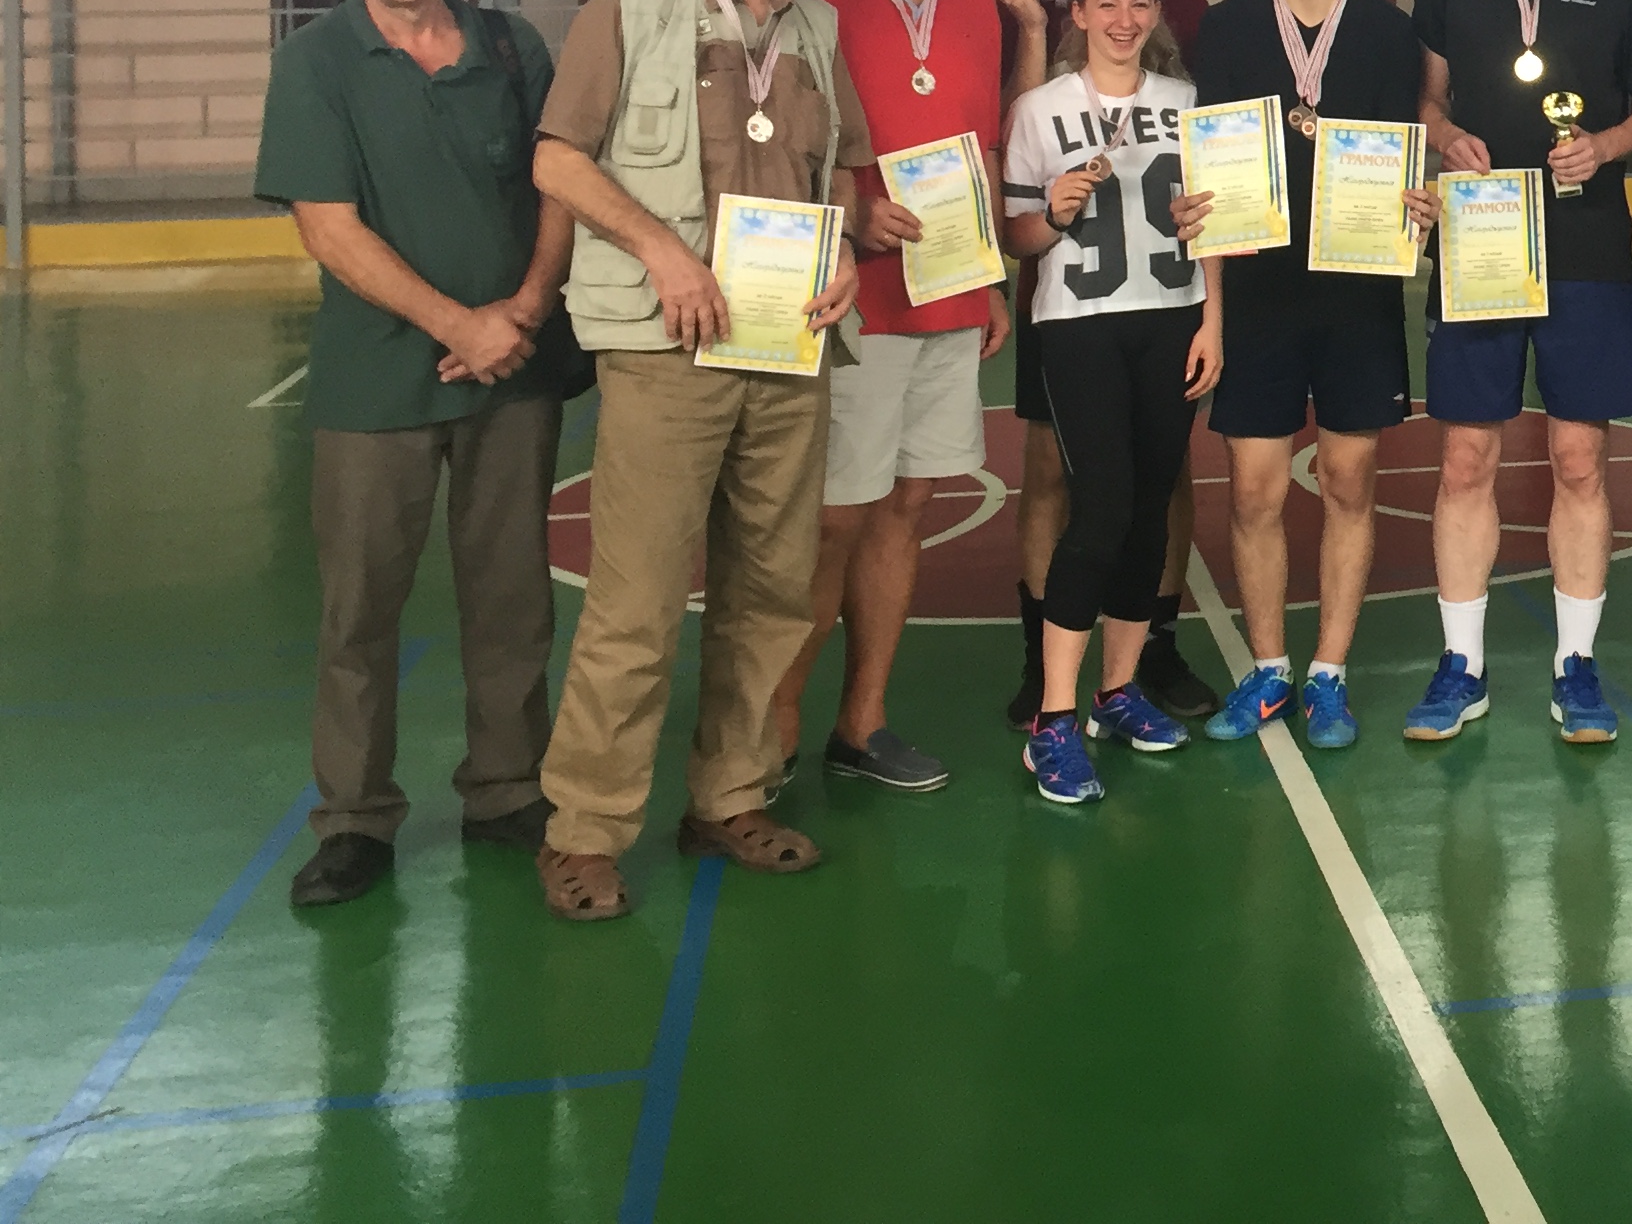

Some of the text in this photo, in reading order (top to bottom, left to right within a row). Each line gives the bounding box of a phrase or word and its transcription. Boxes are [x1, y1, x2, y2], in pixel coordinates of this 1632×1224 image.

[1051, 106, 1180, 156] LIKES
[1339, 152, 1401, 168] ГРАМОТА
[1461, 201, 1521, 215] ГРАМОТА
